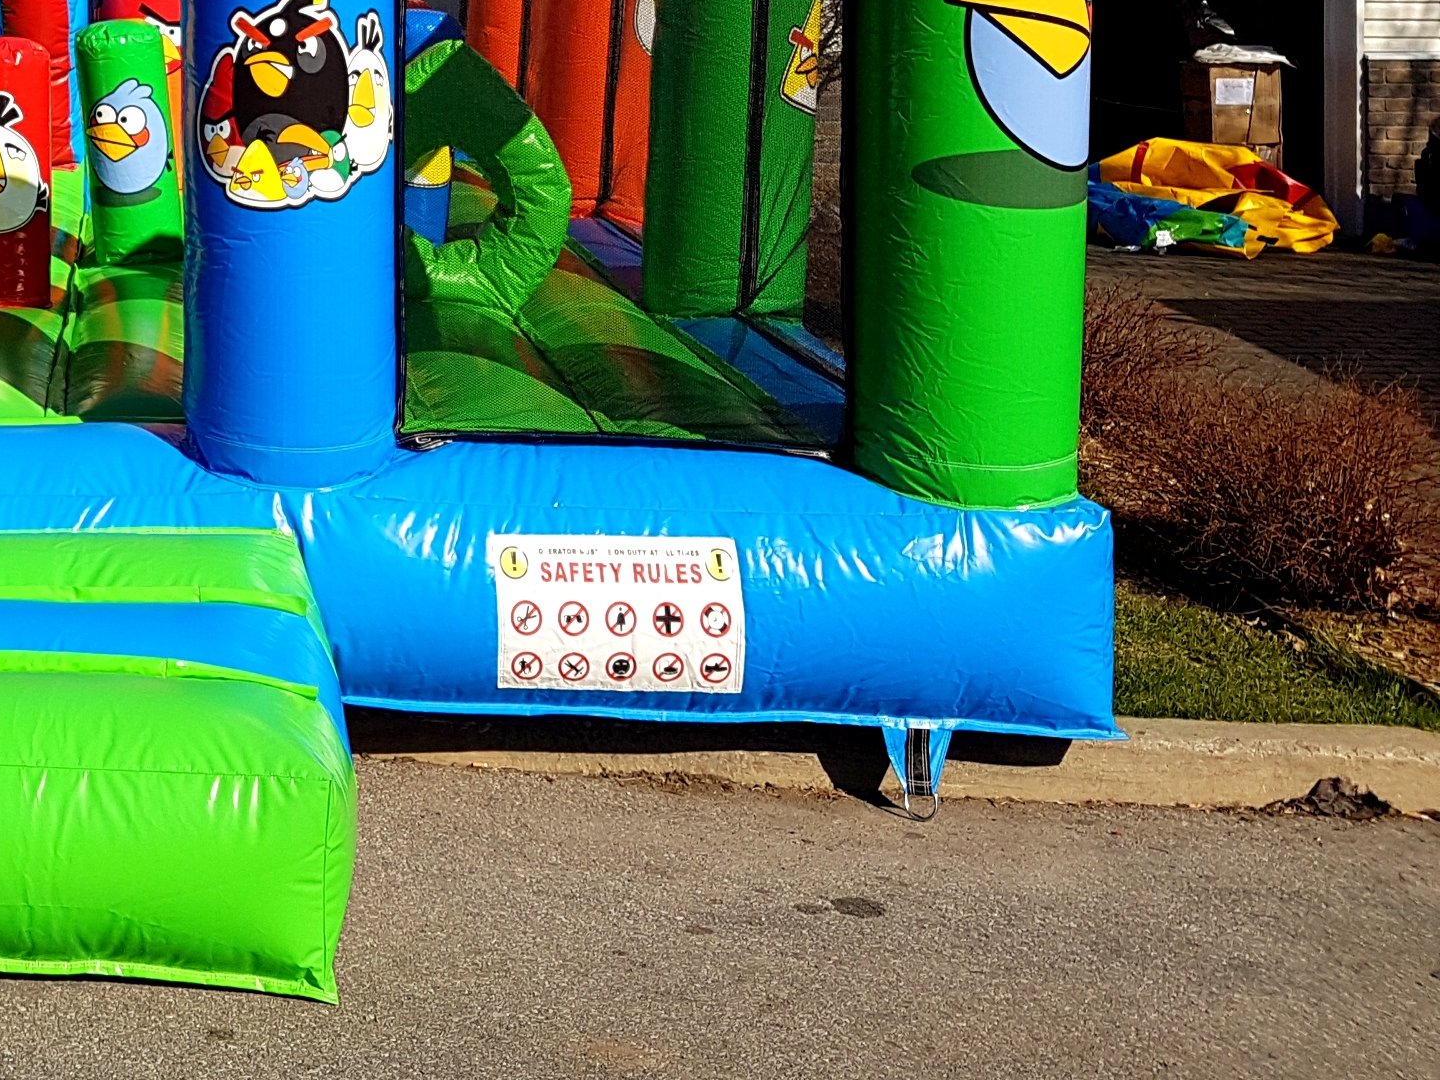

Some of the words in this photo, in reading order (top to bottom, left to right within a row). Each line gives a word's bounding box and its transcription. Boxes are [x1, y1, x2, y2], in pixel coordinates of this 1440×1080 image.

[538, 548, 577, 556] OERATOR
[540, 561, 622, 583] SAFETY
[633, 563, 703, 584] RULES
